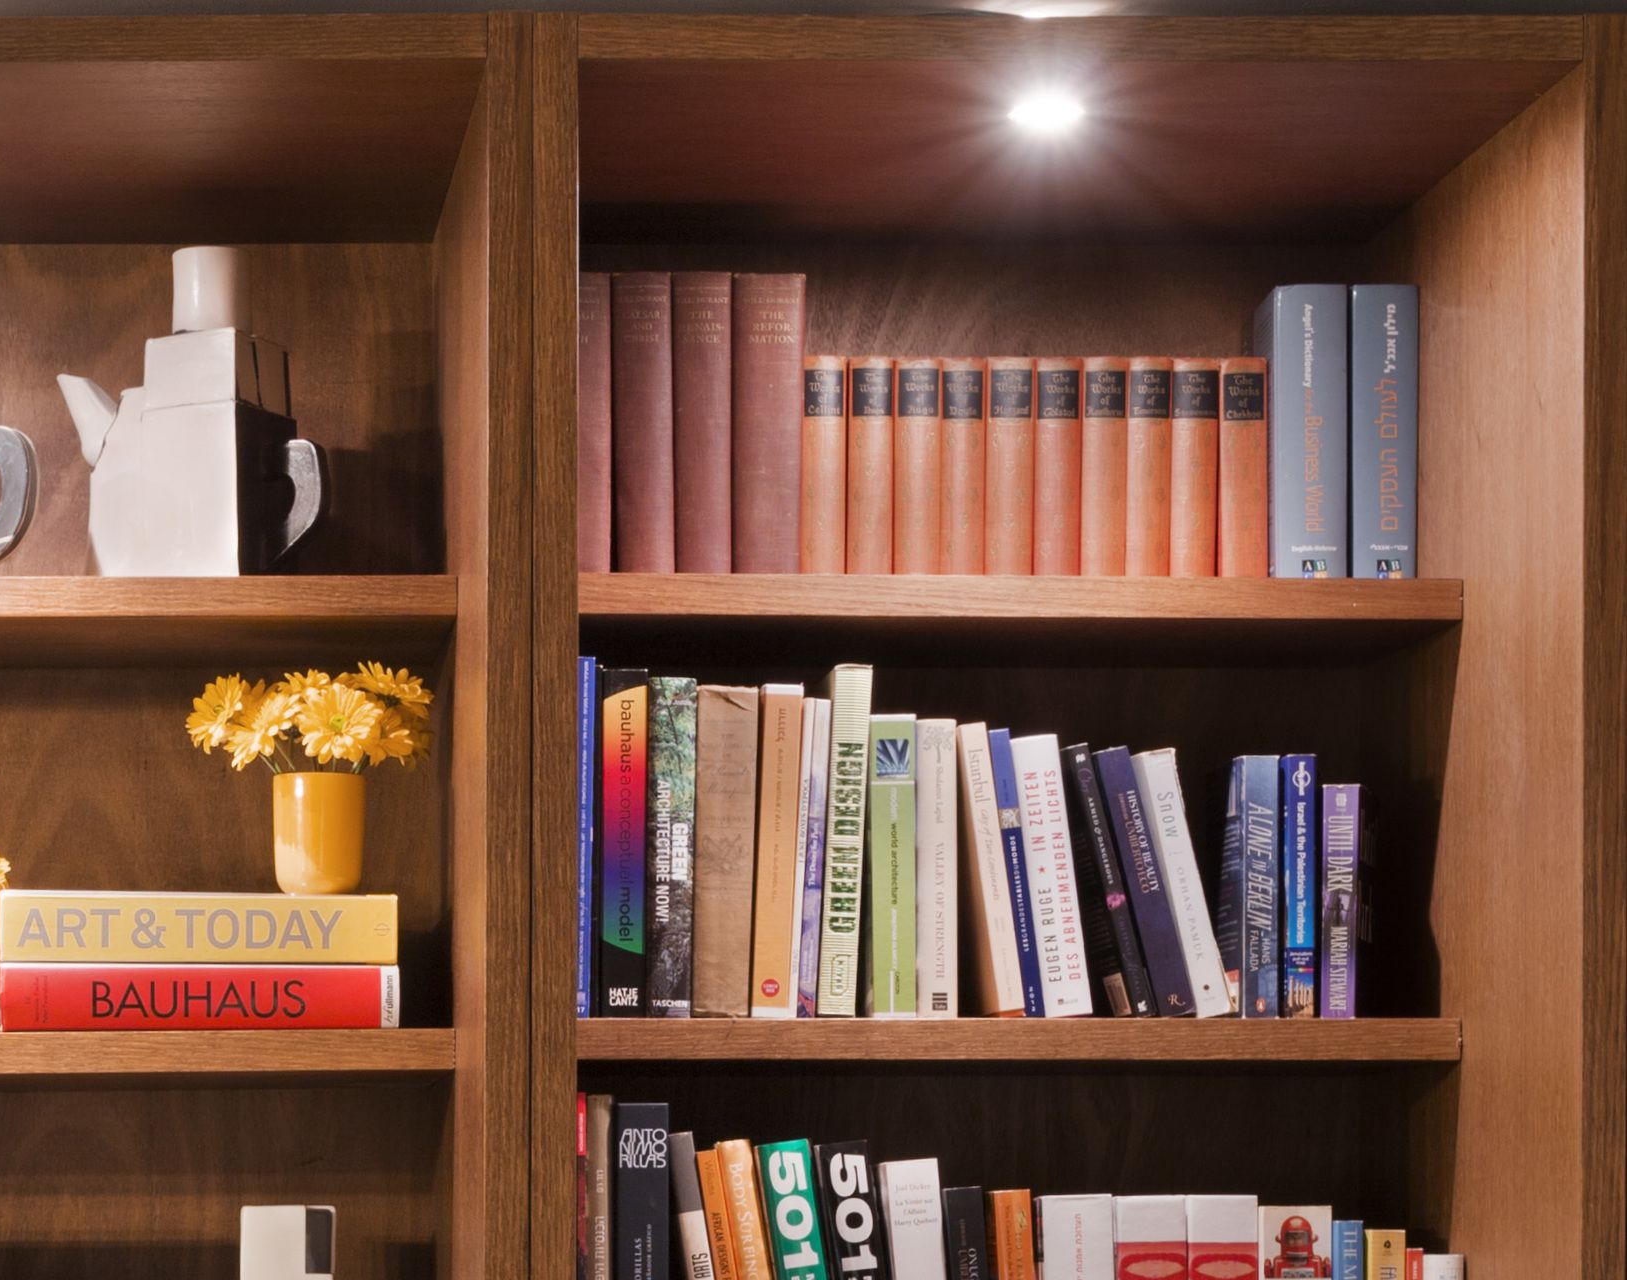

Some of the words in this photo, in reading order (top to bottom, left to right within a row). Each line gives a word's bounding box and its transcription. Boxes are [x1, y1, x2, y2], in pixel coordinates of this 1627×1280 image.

[690, 310, 715, 320] THE
[759, 310, 786, 320] THE
[1383, 303, 1399, 336] מילון
[748, 334, 796, 344] MATION
[1051, 373, 1070, 384] The
[1096, 372, 1116, 384] The
[1142, 373, 1161, 384] The
[1187, 373, 1206, 384] The
[1233, 374, 1253, 386] The
[1302, 339, 1313, 388] Dictionary
[1045, 384, 1076, 395] Works
[1055, 396, 1066, 407] of
[1090, 383, 1122, 395] Works
[1099, 395, 1110, 407] of
[1136, 384, 1166, 395] Works
[1146, 396, 1156, 407] of
[1181, 383, 1211, 395] Works
[1190, 396, 1201, 407] of
[1228, 386, 1260, 397] Works
[1238, 397, 1248, 409] of
[1374, 378, 1398, 439] לעולם
[1304, 415, 1323, 482] Business
[1304, 484, 1325, 533] World
[1379, 448, 1404, 532] העסקים
[620, 700, 635, 773] bauhaus
[620, 775, 632, 786] a
[833, 742, 865, 836] DESIGN
[968, 748, 991, 803] Istanbul
[1024, 771, 1044, 827] ZEITEN
[1044, 770, 1062, 823] LICHTS
[1126, 789, 1147, 834] HISTORY
[1296, 802, 1307, 827] Israel
[617, 787, 634, 885] conceptual
[655, 780, 671, 883] ARCHITECTURE
[890, 823, 899, 848] world
[1031, 836, 1047, 852] IN
[1087, 797, 1099, 826] ARMED
[1097, 836, 1114, 885] DANGEROUS
[1138, 834, 1150, 849] OF
[1247, 801, 1274, 860] ALONE
[1296, 836, 1306, 851] the
[1327, 815, 1354, 854] UNTIL
[671, 822, 689, 881] GREEN
[935, 843, 946, 887] VALLEY
[1125, 821, 1143, 870] UMBERTO
[1137, 870, 1150, 894] ECO
[1141, 850, 1161, 892] BEAUTY
[1252, 859, 1267, 872] IN
[828, 846, 860, 934] GREEN
[890, 850, 899, 905] architecture
[1051, 831, 1078, 944] ABNEHMENDEN
[1157, 791, 1179, 839] Snow
[1176, 866, 1194, 912] ORHAN
[1189, 917, 1205, 961] PAMUK
[1296, 852, 1307, 900] Palestinian
[1327, 856, 1354, 893] DARK
[618, 886, 633, 942] model
[655, 885, 670, 923] NOW!
[935, 891, 946, 909] OF
[1038, 887, 1056, 926] RUGE
[1247, 870, 1274, 932] BERLIN
[17, 907, 122, 950] ART
[129, 907, 167, 950] &
[175, 908, 344, 950] TODAY
[1296, 899, 1307, 945] Territories
[935, 911, 946, 979] STRENGTH
[1044, 934, 1062, 982] EUGEN
[1249, 929, 1260, 972] FALLADA
[1261, 937, 1271, 964] HANS
[1329, 926, 1348, 966] MARIAH
[1066, 953, 1082, 981] DES
[90, 979, 307, 1020] BAUHAUS
[609, 987, 638, 997] HATJE
[609, 996, 638, 1006] CANTZ
[651, 1000, 690, 1008] TASCHEN
[1329, 967, 1347, 1011] STEWART
[619, 1128, 668, 1142] ANTO
[619, 1141, 668, 1155] NIMO
[619, 1154, 667, 1168] RILLAS
[728, 1162, 747, 1209] BODY
[768, 1150, 820, 1270] 501
[829, 1152, 878, 1272] 501
[594, 1215, 606, 1260] הכנסיות
[712, 1212, 724, 1240] AFRICAN
[718, 1243, 730, 1275] DESIGNS
[967, 1247, 979, 1266] ON
[1342, 1230, 1359, 1263] THE
[692, 1252, 709, 1279] ARTS
